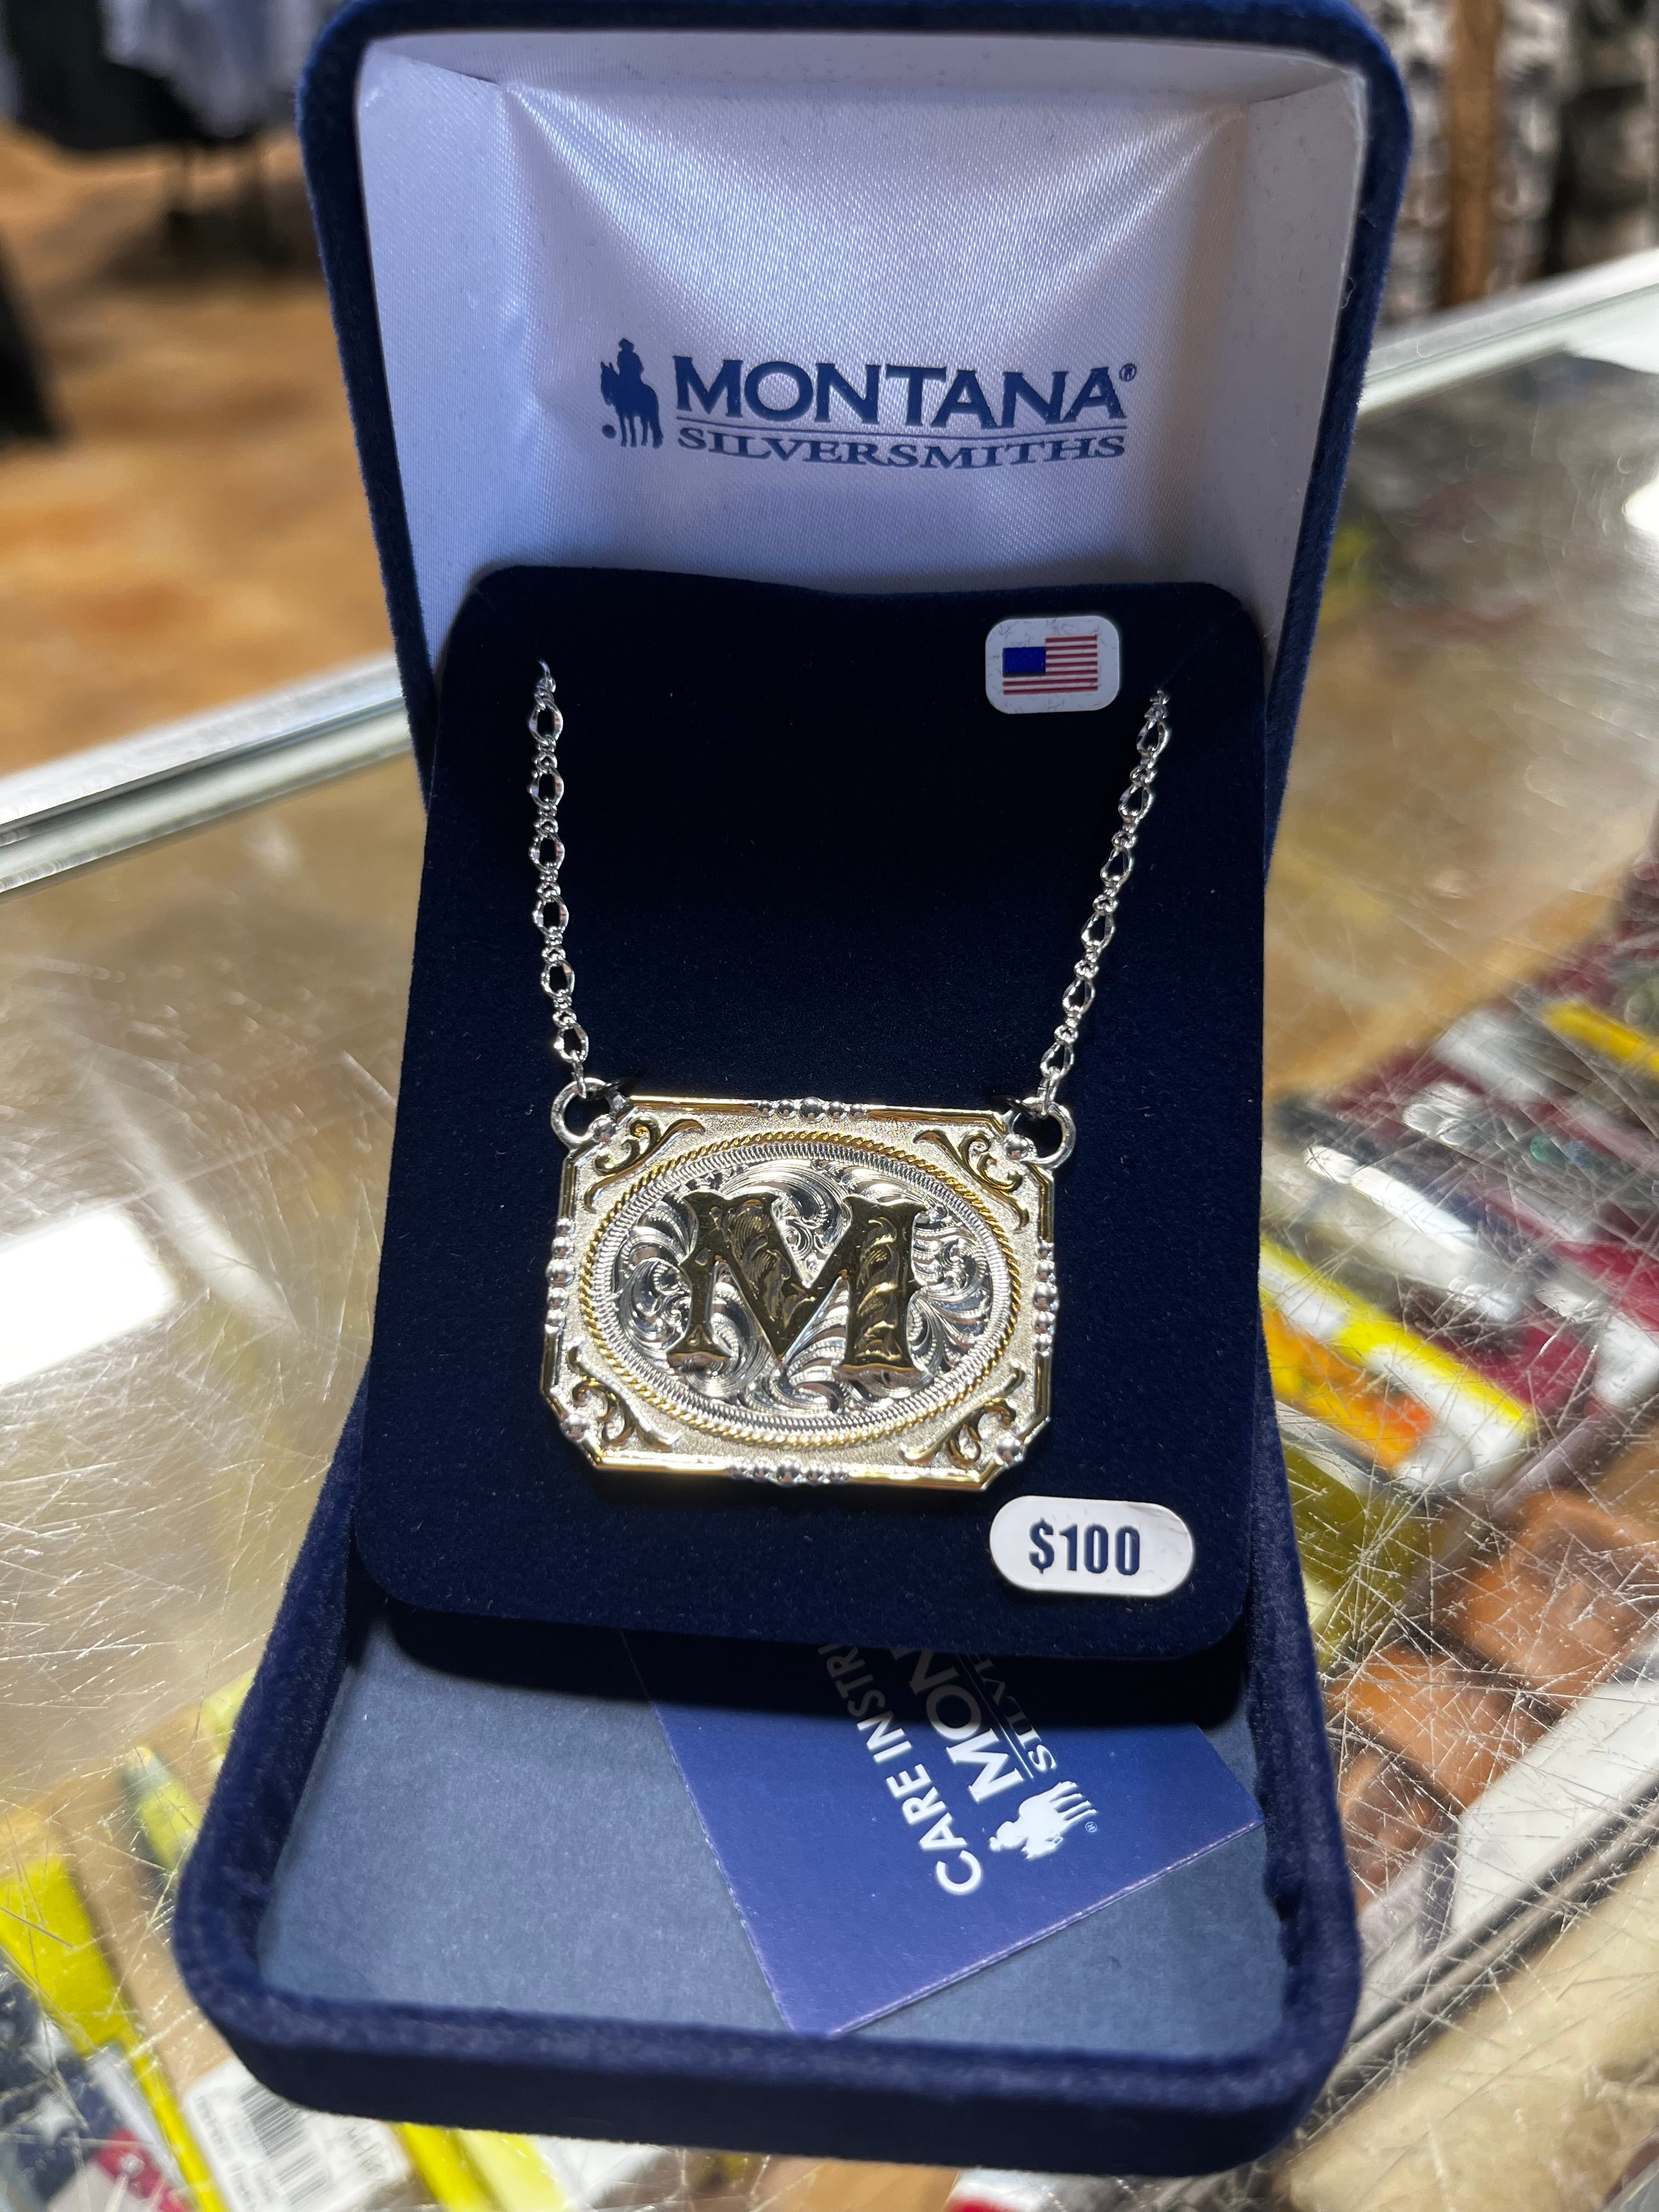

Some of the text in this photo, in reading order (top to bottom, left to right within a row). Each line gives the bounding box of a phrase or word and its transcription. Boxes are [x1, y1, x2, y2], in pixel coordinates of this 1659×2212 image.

[676, 427, 1126, 470] SILVERSMITHS
[665, 1189, 927, 1383] M
[1028, 1517, 1140, 1576] $100
[884, 1763, 983, 1895] CARE
